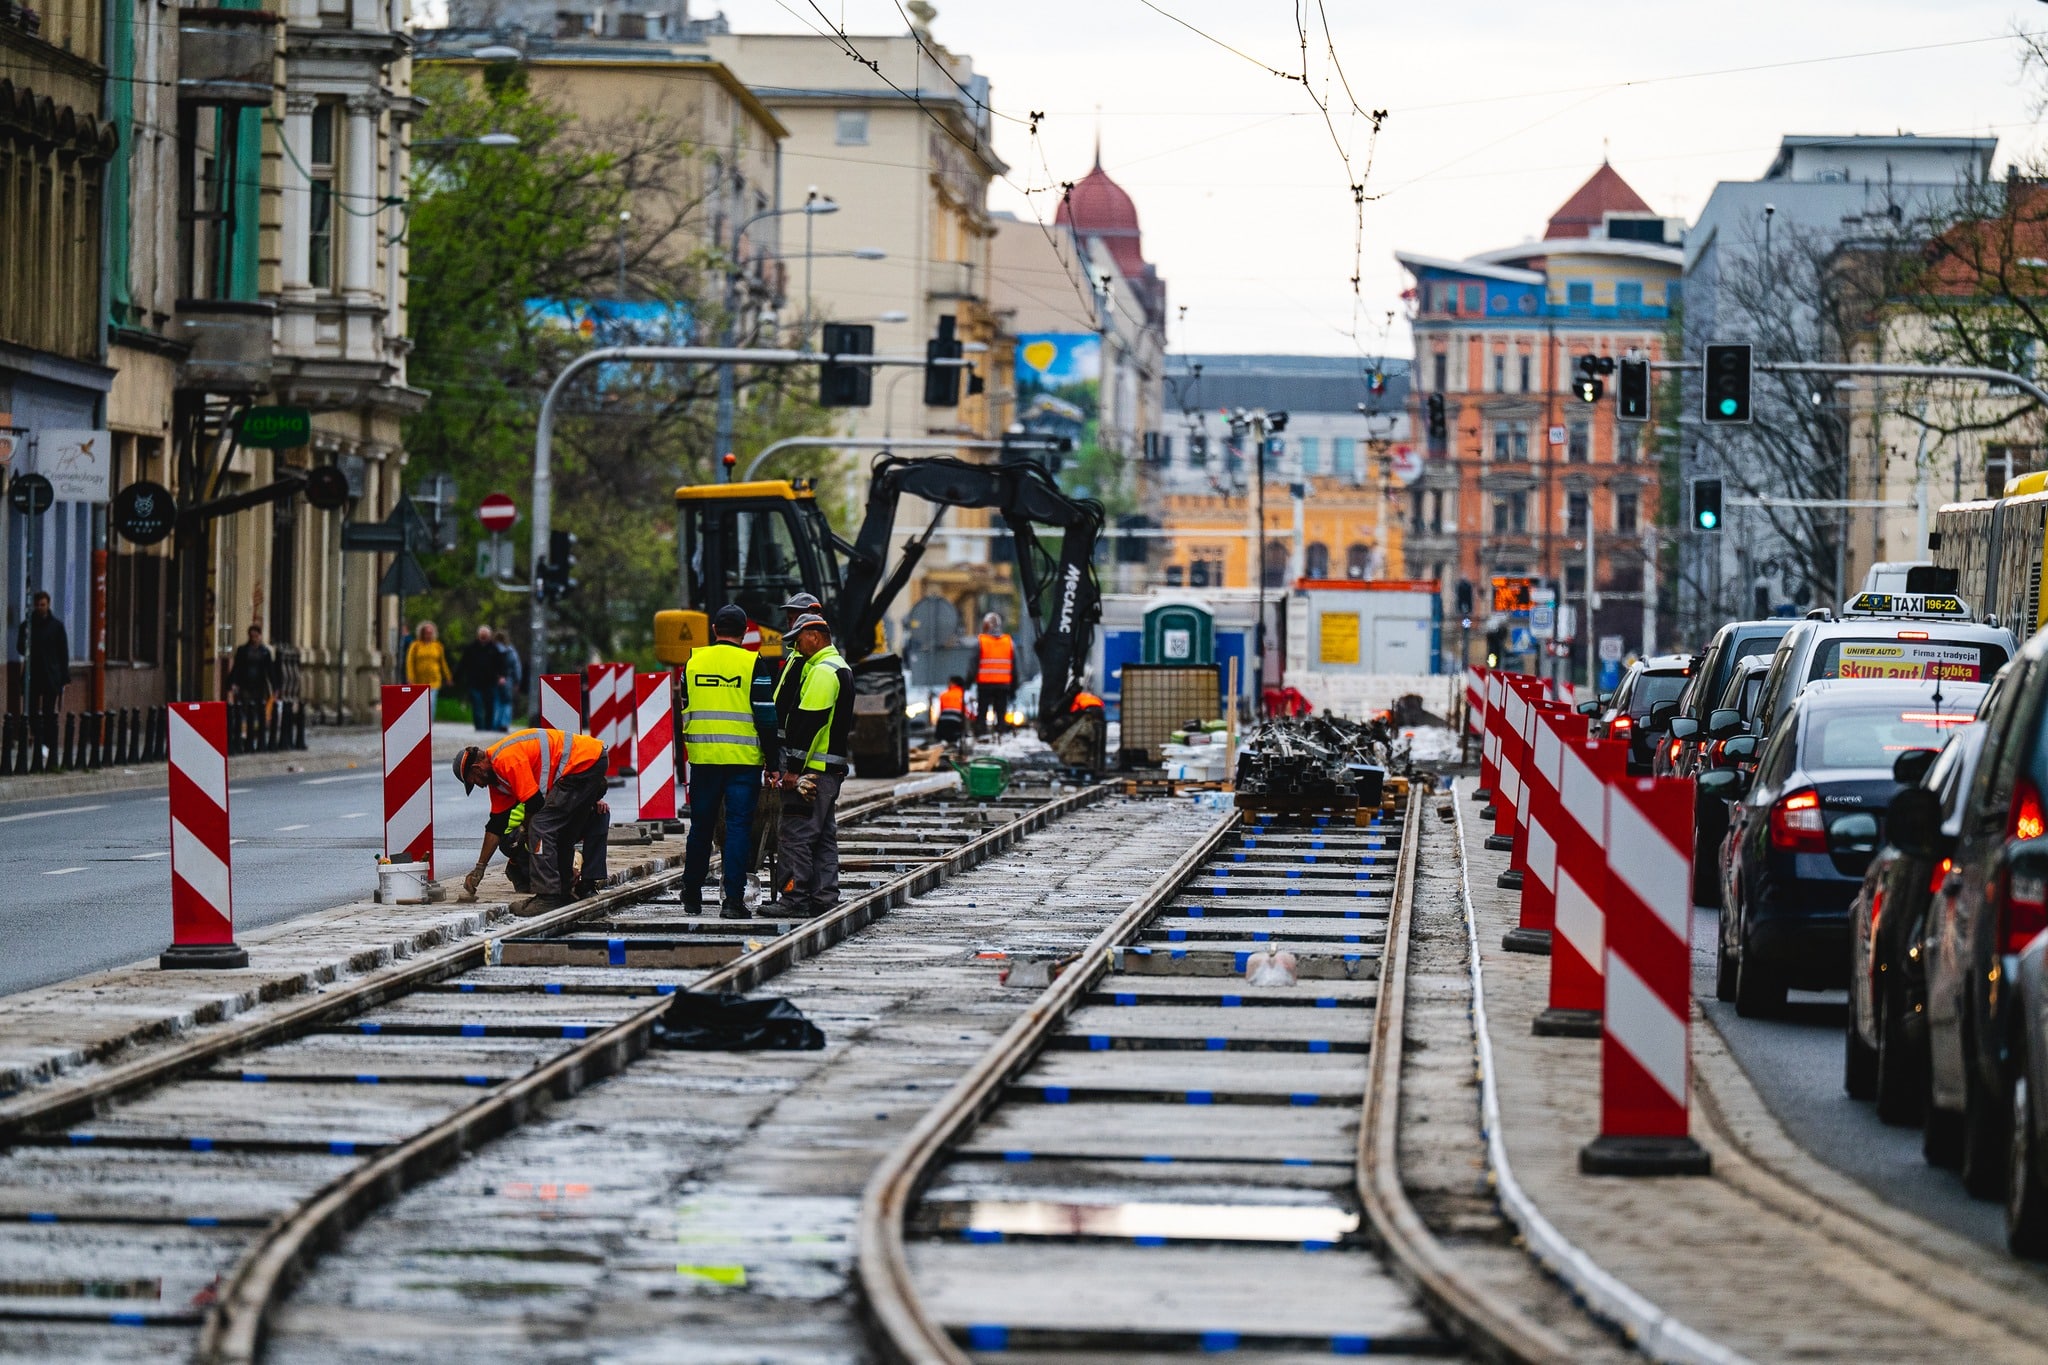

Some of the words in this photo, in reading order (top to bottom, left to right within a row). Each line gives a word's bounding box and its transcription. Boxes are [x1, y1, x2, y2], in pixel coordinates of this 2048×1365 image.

[1893, 597, 1923, 612] TAXI
[1925, 600, 1957, 610] 196-22
[1846, 647, 1875, 655] UNIWER
[1913, 649, 1935, 658] Firma
[1943, 651, 1978, 661] tradycja!
[1932, 664, 1973, 678] szybka
[695, 674, 741, 688] GM
